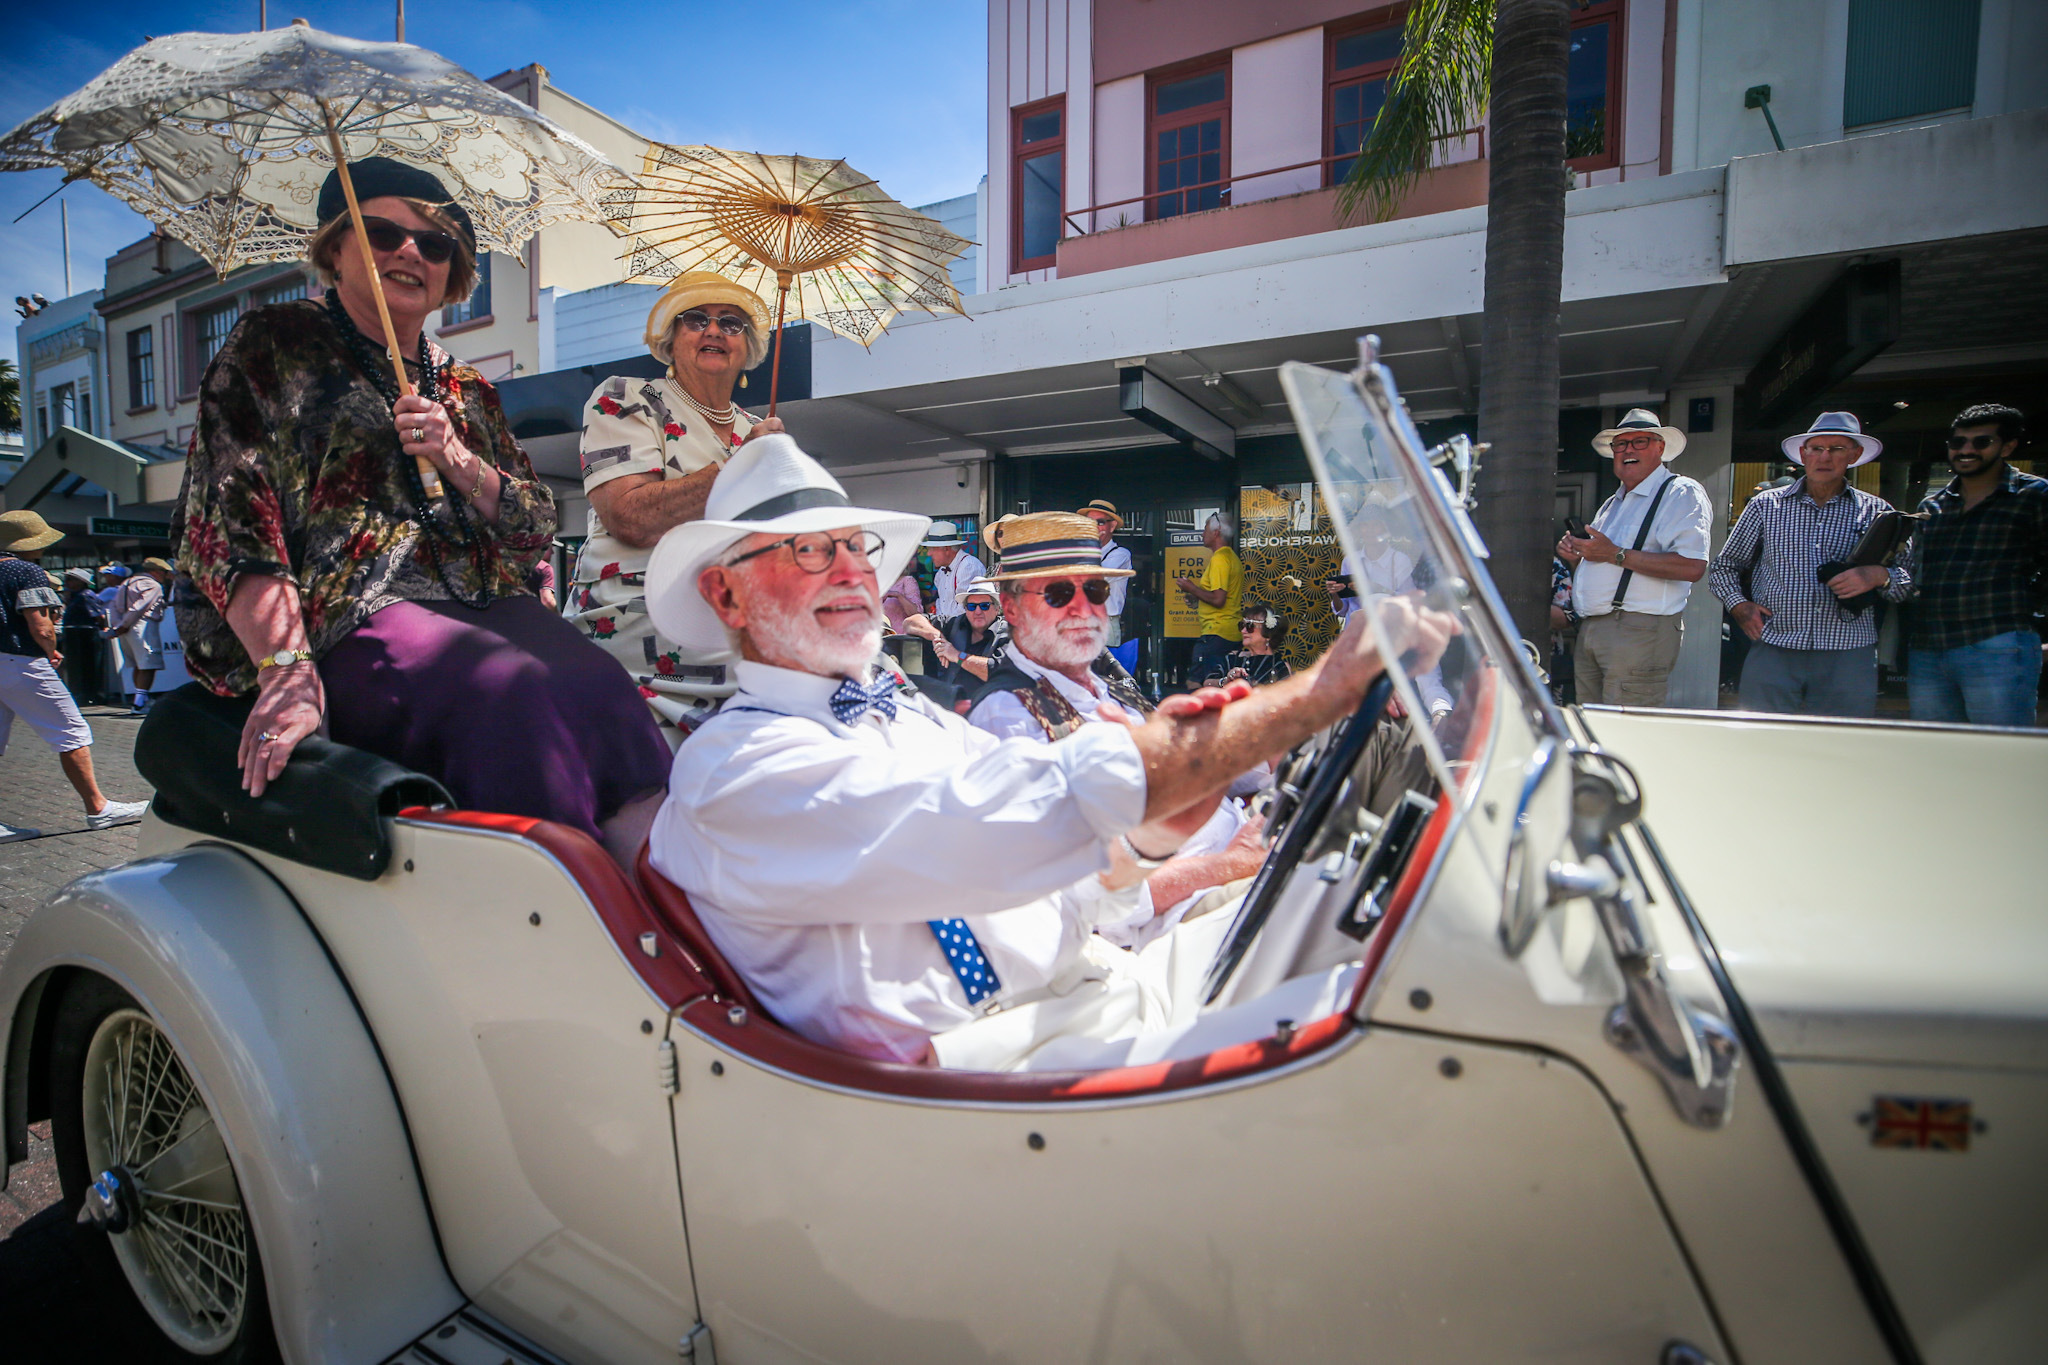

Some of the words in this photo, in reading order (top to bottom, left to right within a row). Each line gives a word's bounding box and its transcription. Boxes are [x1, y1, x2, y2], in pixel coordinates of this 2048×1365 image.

[99, 523, 124, 534] THE
[129, 525, 164, 536] BODY
[1179, 557, 1204, 567] FOR
[1172, 569, 1206, 579] LEAS
